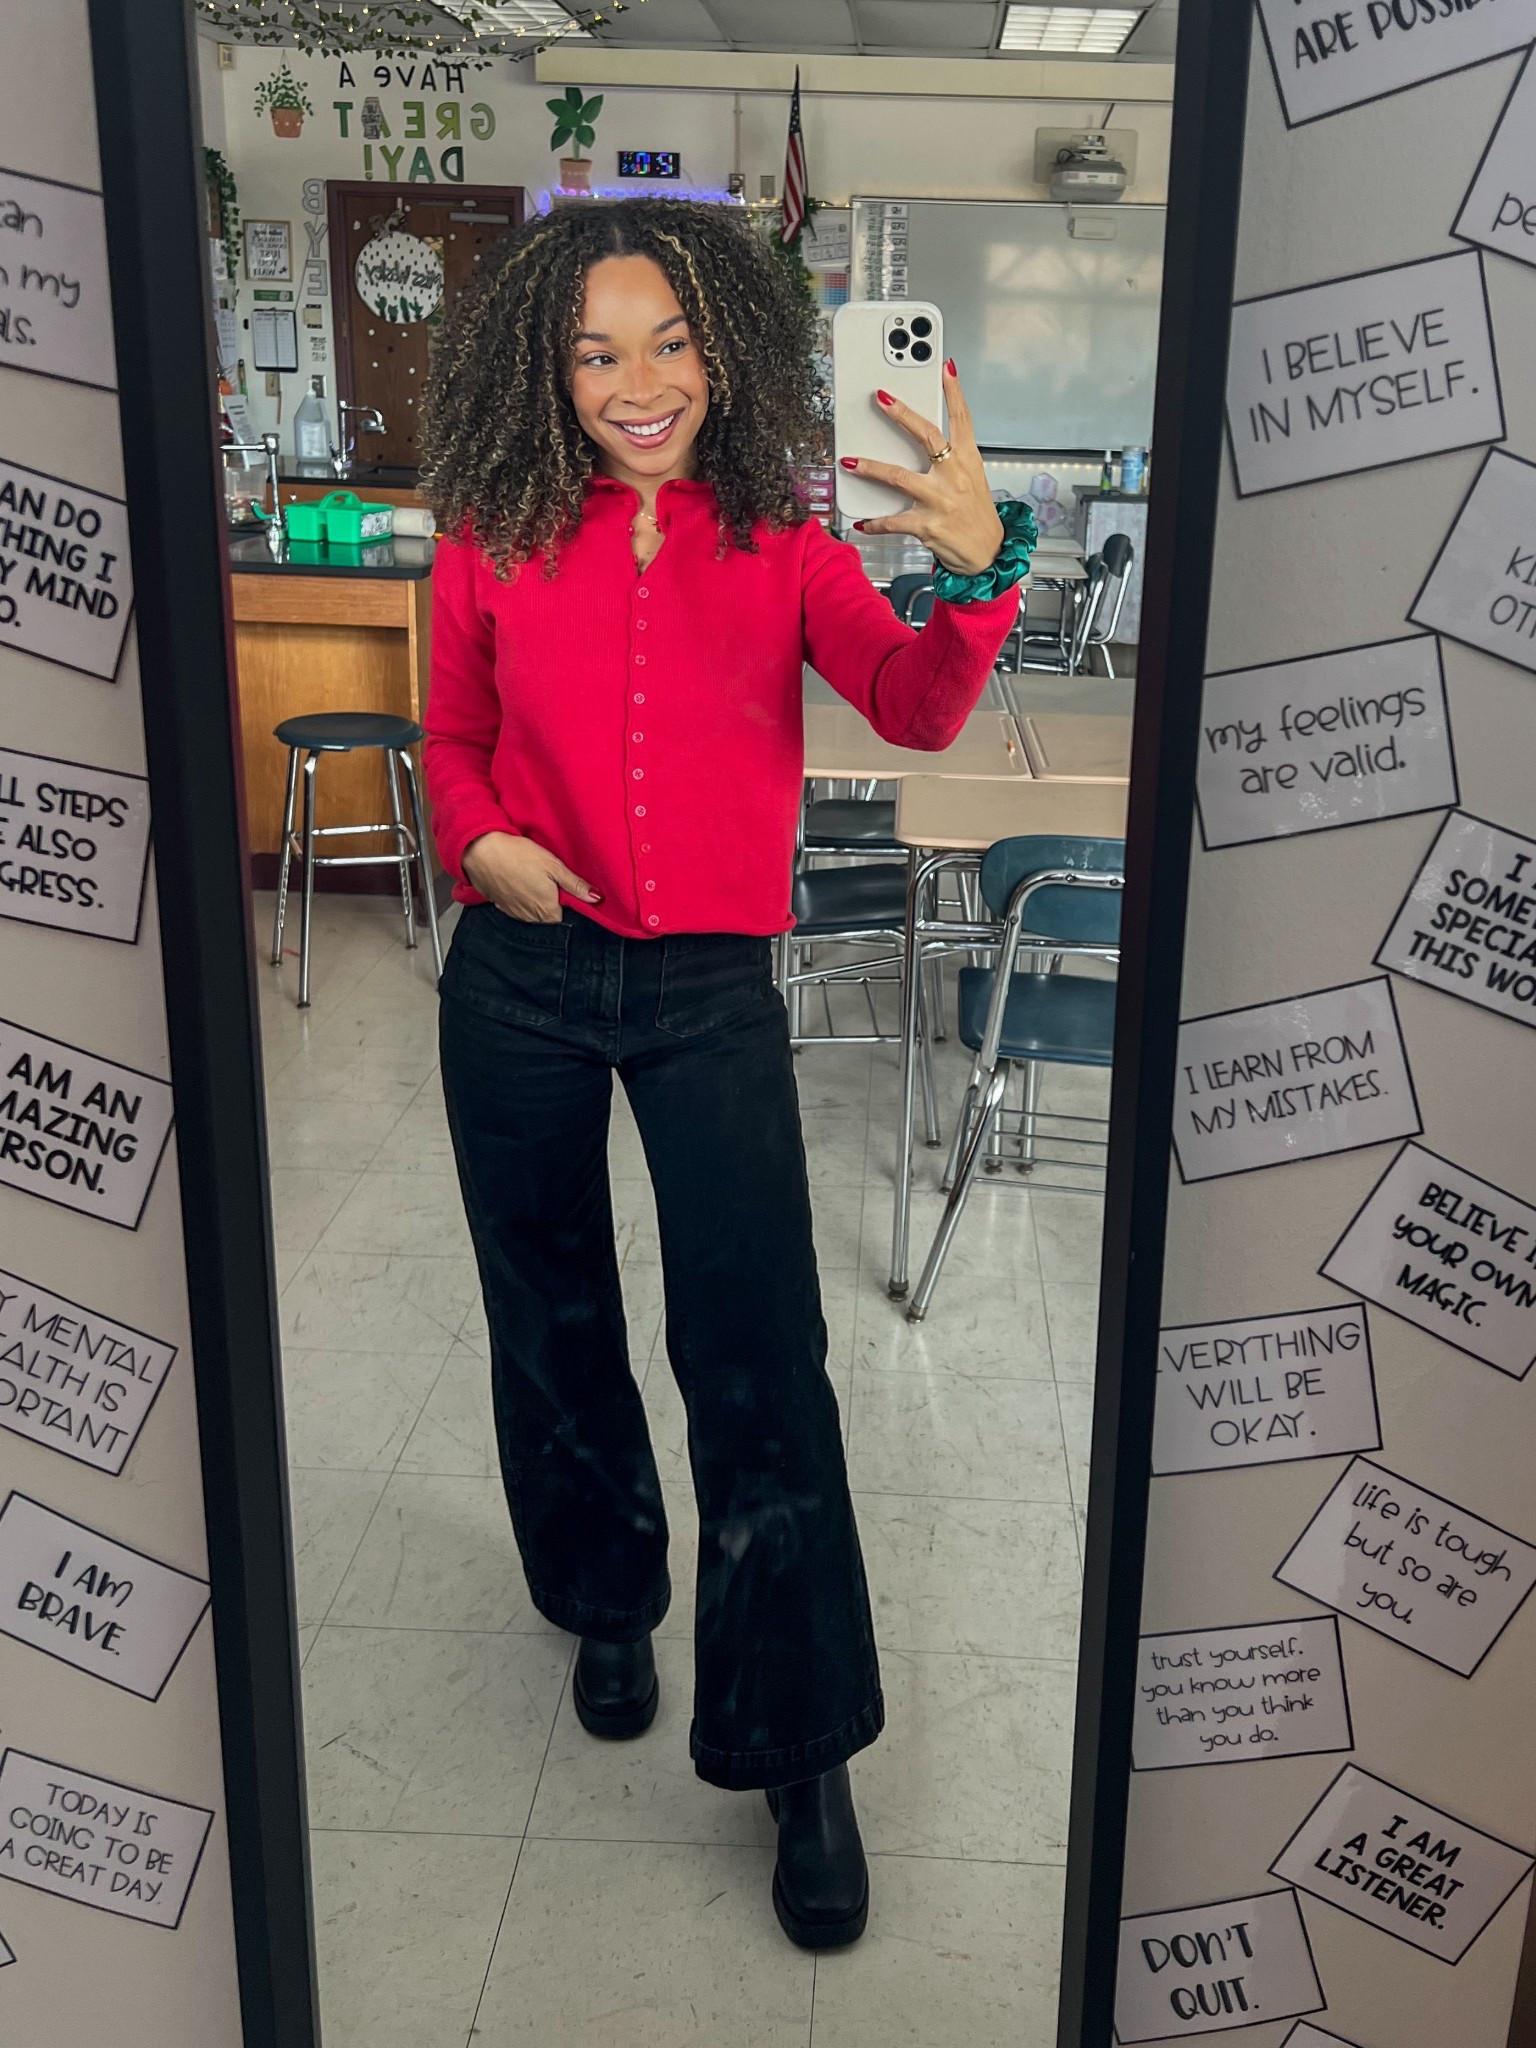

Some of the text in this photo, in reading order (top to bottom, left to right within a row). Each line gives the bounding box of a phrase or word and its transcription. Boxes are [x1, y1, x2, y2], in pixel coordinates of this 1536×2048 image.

[1296, 12, 1358, 69] ARE
[0, 199, 43, 238] an
[21, 264, 80, 309] my
[1262, 308, 1449, 385] I BELIEVE
[1250, 360, 1479, 444] IN MYSELF.
[54, 498, 102, 538] DO
[24, 566, 118, 619] MIND
[96, 551, 118, 584] I
[1205, 687, 1426, 754] my feelings
[1240, 735, 1406, 794] are valid.
[37, 782, 129, 828] STEPS
[16, 823, 97, 861] ALSO
[1504, 853, 1533, 883] I
[1408, 930, 1480, 979] THIS
[7, 1052, 142, 1124] AM AN
[1183, 1030, 1375, 1094] I LEARN FROM
[1191, 1069, 1389, 1134] MY MISTAKES.
[0, 1126, 105, 1195] RSON.
[1418, 1181, 1529, 1253] BELIEVE
[1396, 1263, 1488, 1327] MAGIC.
[22, 1302, 153, 1384] MENTAL
[1156, 1322, 1361, 1373] VERYTHING
[0, 1333, 127, 1412] ALTH IS
[1186, 1367, 1326, 1410] WILL BE
[1210, 1411, 1316, 1447] OKAY.
[54, 1550, 72, 1579] I
[1344, 1521, 1478, 1607] but so are
[1404, 1507, 1430, 1535] is
[1434, 1521, 1512, 1582] tough
[17, 1581, 127, 1656] BRAVE.
[1356, 1582, 1414, 1625] you.
[1151, 1636, 1304, 1670] trust yourself.
[1141, 1667, 1321, 1703] you know more
[1156, 1694, 1315, 1725] than you think
[1200, 1724, 1279, 1752] you do.
[46, 1782, 158, 1836] TODAY IS
[9, 1806, 174, 1875] GOING TO BE
[1343, 1832, 1465, 1900] A GREAT
[1381, 1814, 1462, 1868] I AM
[0, 1838, 163, 1905] A GREAT DAY.
[1314, 1847, 1447, 1930] LISTENER.
[1170, 1976, 1260, 2021] QUIT.
